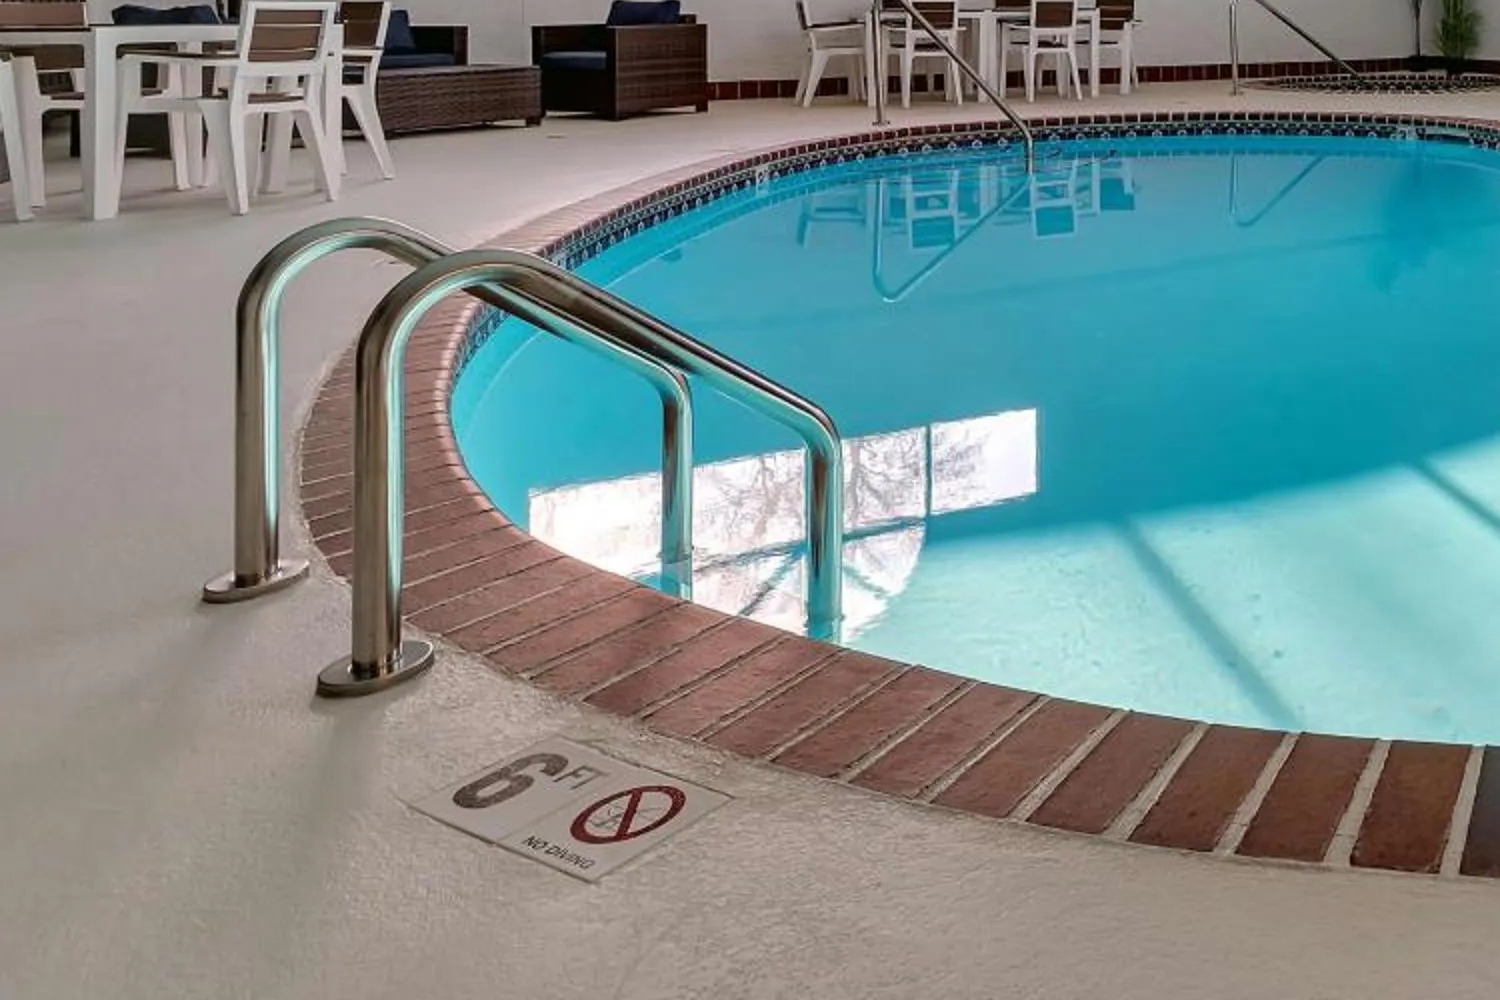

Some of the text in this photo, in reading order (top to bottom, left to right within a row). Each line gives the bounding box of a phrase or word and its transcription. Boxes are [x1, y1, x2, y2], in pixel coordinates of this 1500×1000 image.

[452, 753, 609, 809] 6 FT
[520, 835, 597, 869] NO DIVING
